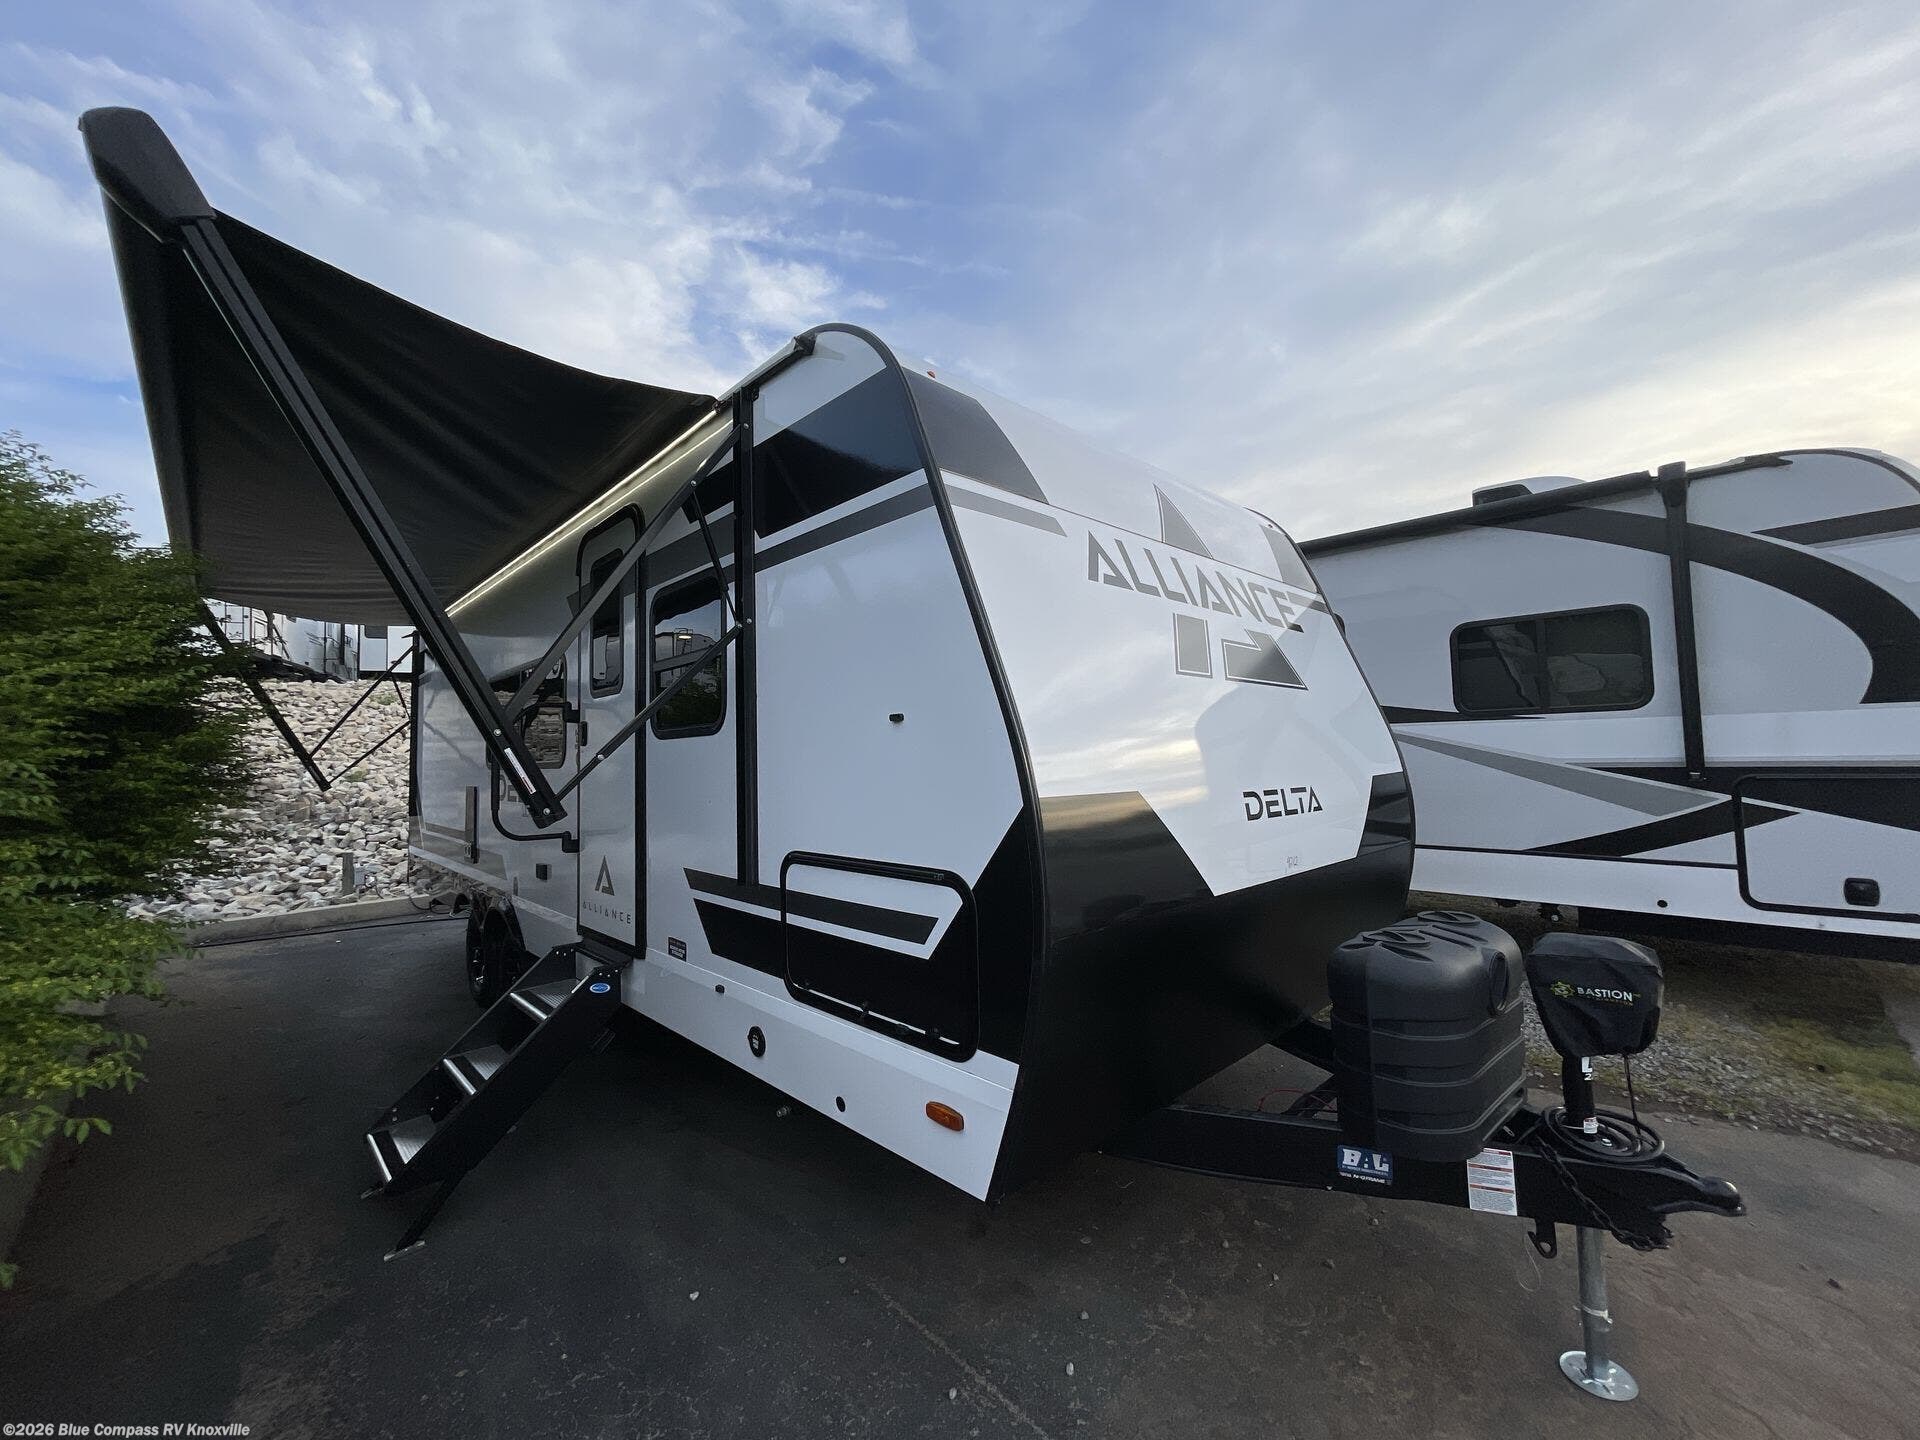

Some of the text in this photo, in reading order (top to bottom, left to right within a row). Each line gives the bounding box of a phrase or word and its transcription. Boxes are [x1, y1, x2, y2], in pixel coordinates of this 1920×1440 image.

[1088, 530, 1304, 633] ALLIANCE
[1242, 786, 1323, 821] DELTA
[582, 901, 632, 924] ALLIANCE
[1577, 987, 1633, 1002] BASTION
[1342, 1148, 1389, 1172] BAL
